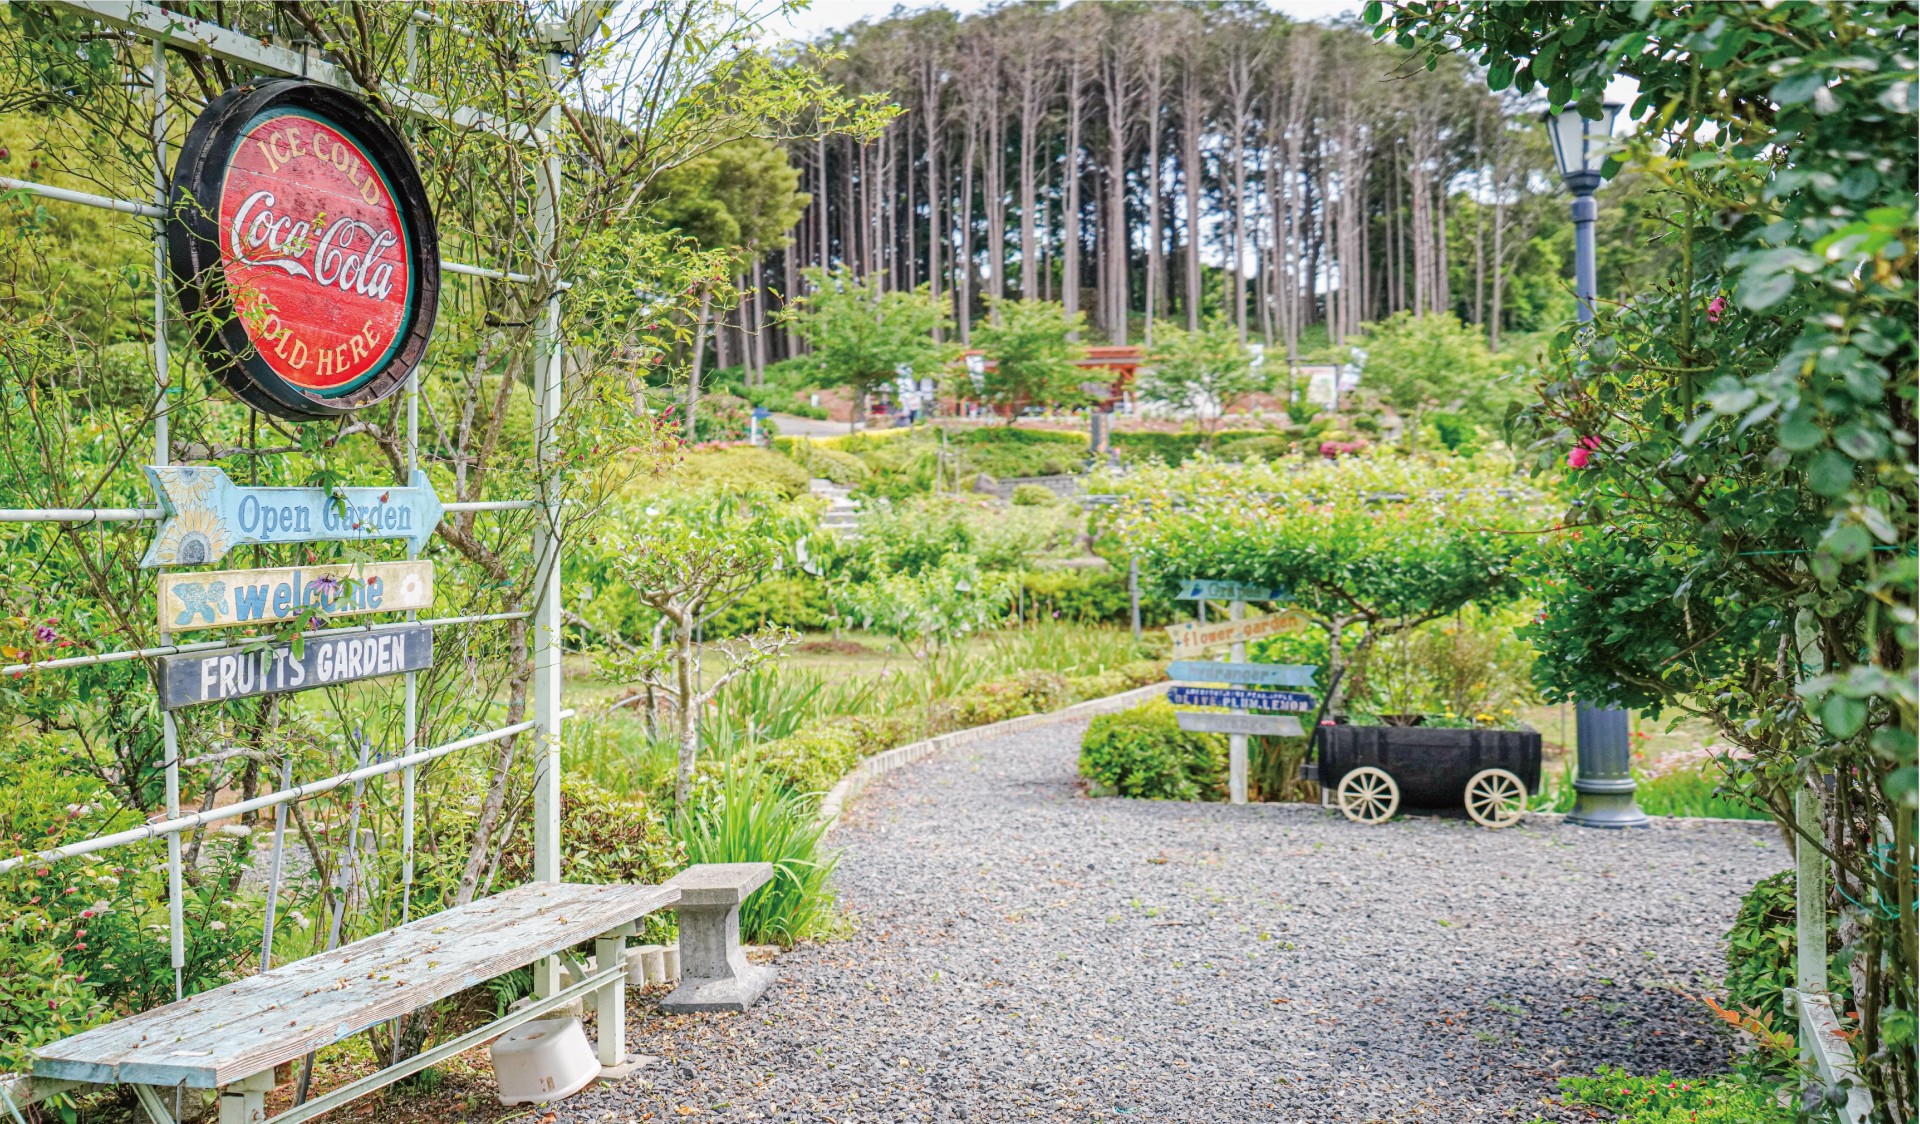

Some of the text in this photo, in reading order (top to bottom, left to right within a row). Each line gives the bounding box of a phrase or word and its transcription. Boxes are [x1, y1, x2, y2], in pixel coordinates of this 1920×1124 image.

[257, 127, 381, 206] ICE COLD
[230, 190, 398, 301] Coca-Cola
[316, 319, 381, 376] HERE
[238, 494, 412, 540] Open Garden
[234, 569, 384, 622] welcome
[1183, 615, 1298, 647] flower garden
[200, 633, 405, 701] FRUITS GARDEN
